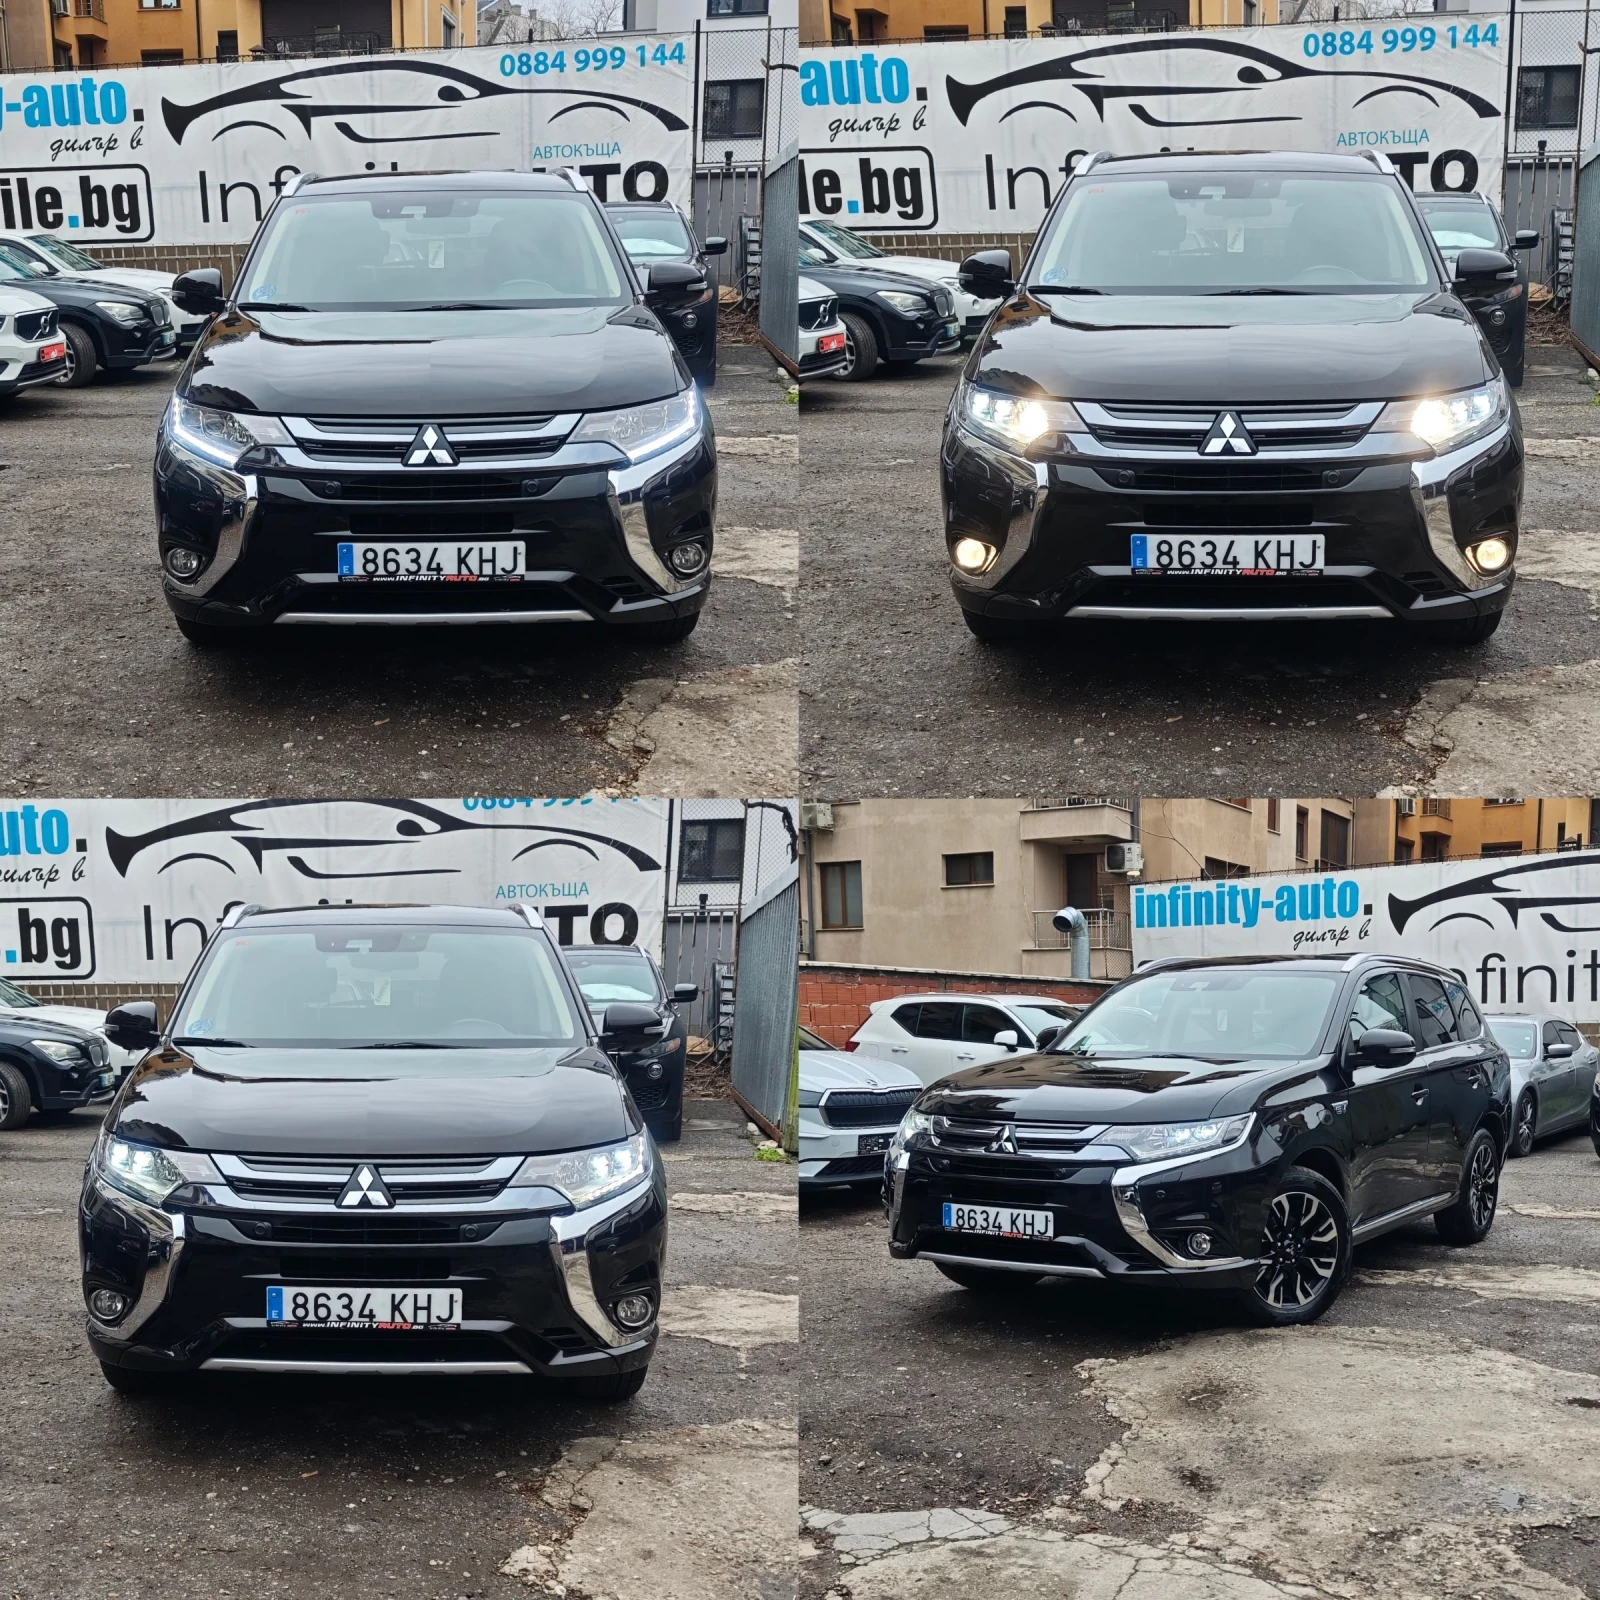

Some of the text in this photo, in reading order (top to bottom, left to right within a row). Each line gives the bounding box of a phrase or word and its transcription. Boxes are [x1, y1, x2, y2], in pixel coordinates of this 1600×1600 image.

[1303, 23, 1499, 57] 0884 999 144
[500, 42, 686, 76] 0884 999 144
[828, 113, 902, 142] дилър
[1336, 128, 1430, 147] АВТОКЪЩА
[50, 133, 119, 161] дилър
[533, 141, 621, 159] АВТОКЪЩА
[362, 546, 518, 576] 8634 KHJ
[1156, 540, 1317, 569] 8634 KHJ
[0, 864, 60, 889] илър
[495, 881, 590, 899] АВТОКЪЩА
[956, 1207, 1049, 1235] 8634 KHJ
[292, 1292, 455, 1323] 8634 KHJ
